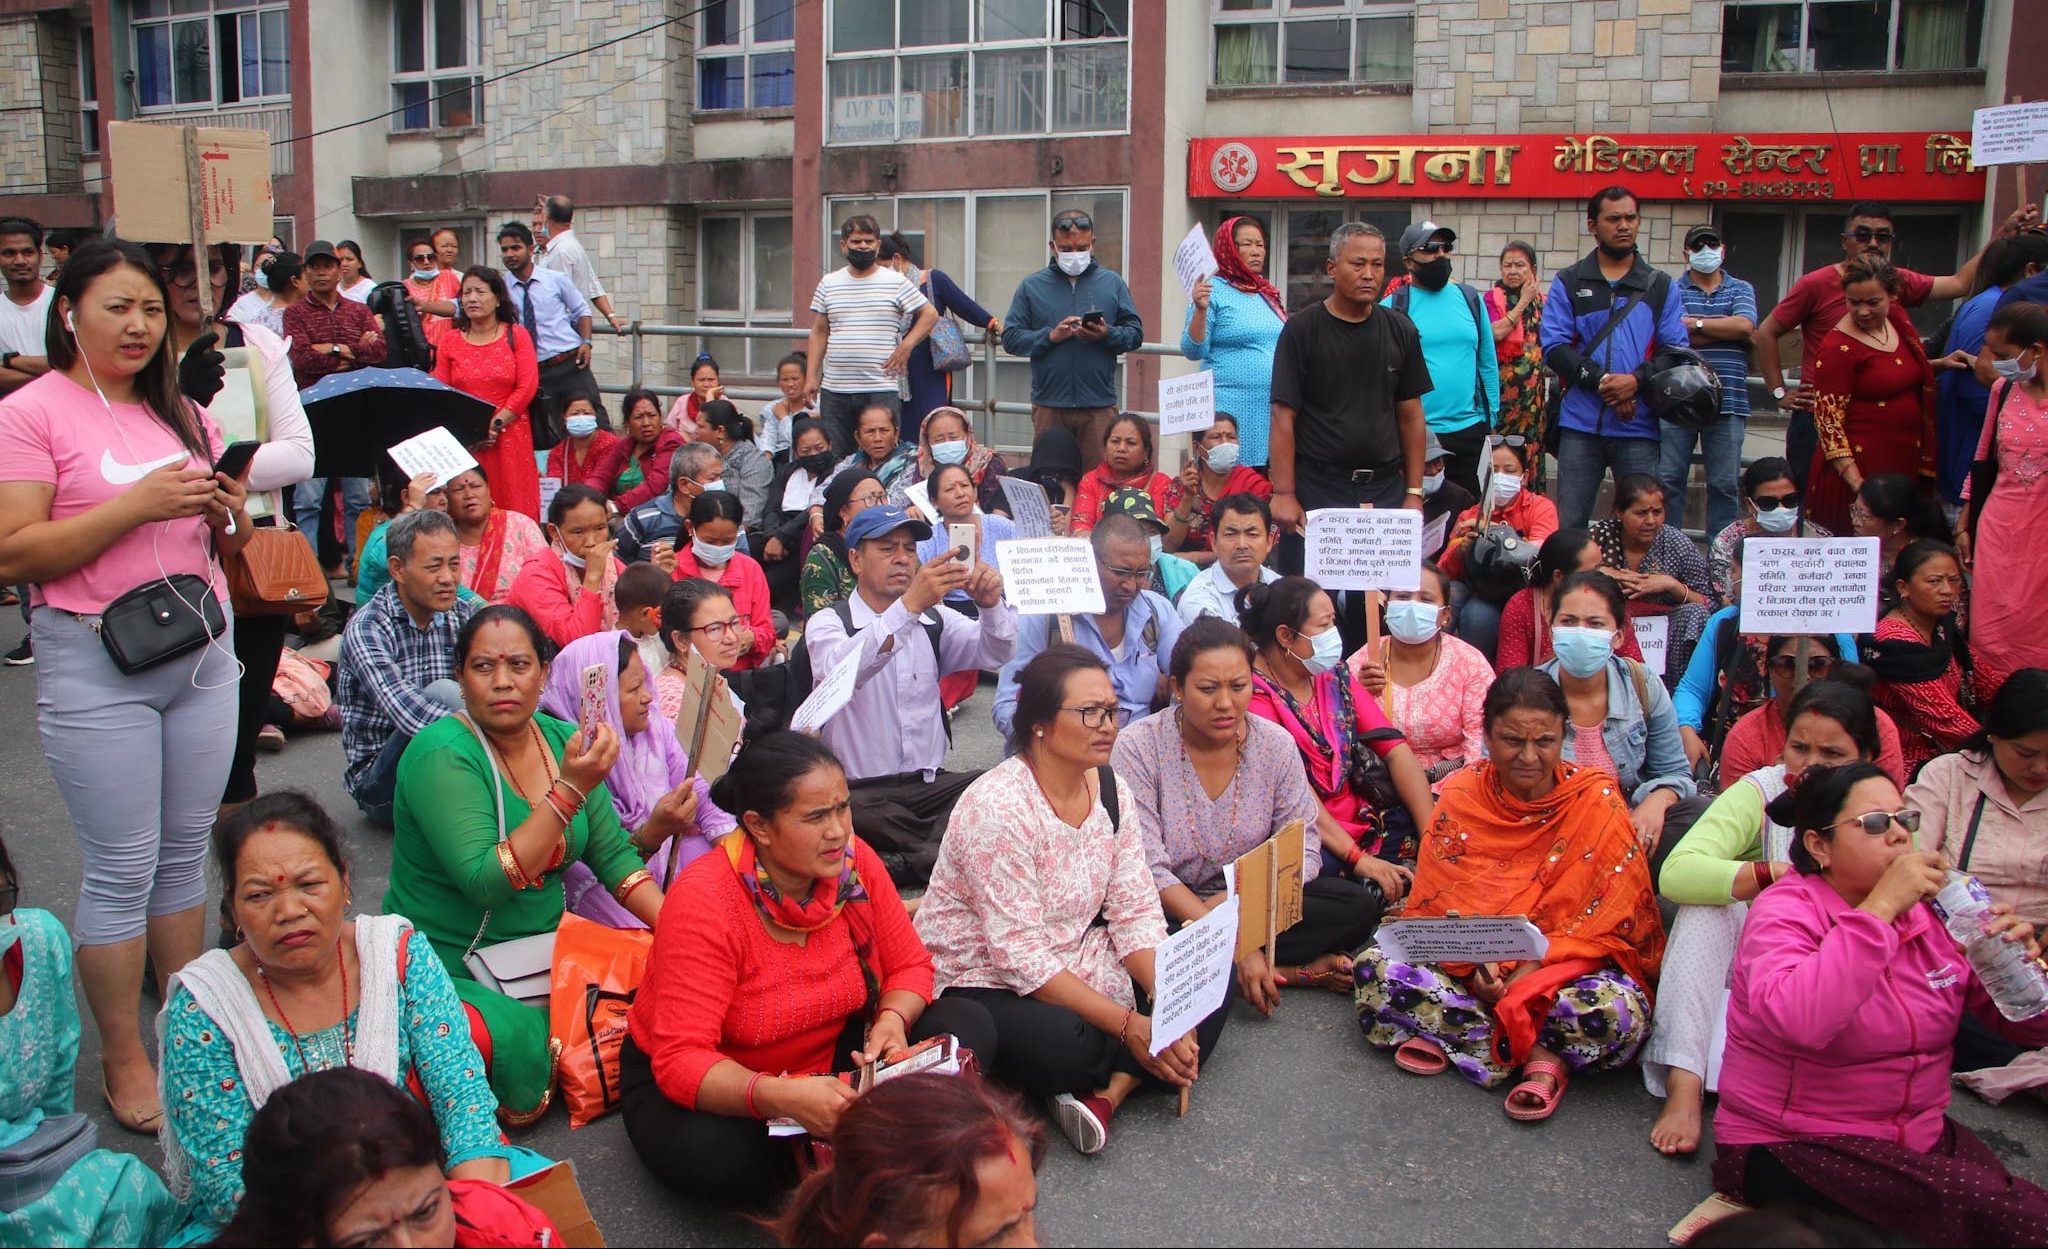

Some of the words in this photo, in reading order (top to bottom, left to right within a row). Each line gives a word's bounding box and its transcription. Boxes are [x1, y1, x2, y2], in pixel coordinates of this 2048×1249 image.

[845, 100, 873, 118] IVF
[879, 97, 915, 115] UNT
[1276, 145, 1520, 196] सृजना
[1553, 135, 1697, 175] मेडिकल
[1721, 136, 1832, 175] सेन्टर
[1858, 143, 1904, 177] प्रा.
[1345, 526, 1375, 535] सहकारी
[1320, 536, 1342, 545] समिति
[1352, 536, 1382, 546] कर्मचारी
[1391, 538, 1412, 546] उनका
[1319, 546, 1344, 555] परिवार
[1379, 547, 1412, 556] नातागोता
[1772, 548, 1796, 556] फरार
[1803, 547, 1822, 556] बन्द
[1827, 548, 1846, 556] बचत
[1851, 547, 1868, 555] तथा
[1064, 556, 1088, 564] सहकारी
[1326, 557, 1351, 566] निजका
[1354, 558, 1368, 566] तीन
[1790, 558, 1825, 568] सहकारी
[1347, 568, 1370, 578] रोक्का
[1759, 571, 1786, 580] समिति
[1798, 571, 1833, 580] कर्मचारी
[1843, 572, 1867, 580] उनका
[1758, 583, 1787, 592] परिवार
[1792, 584, 1825, 592] आफन्त
[1829, 583, 1866, 592] नातागोता
[1766, 596, 1796, 605] निजका
[1798, 596, 1816, 605] तीन
[1838, 595, 1866, 605] सम्पति
[1756, 610, 1788, 618] तत्काल
[1792, 608, 1818, 618] रोक्का
[1642, 639, 1664, 649] पायो
